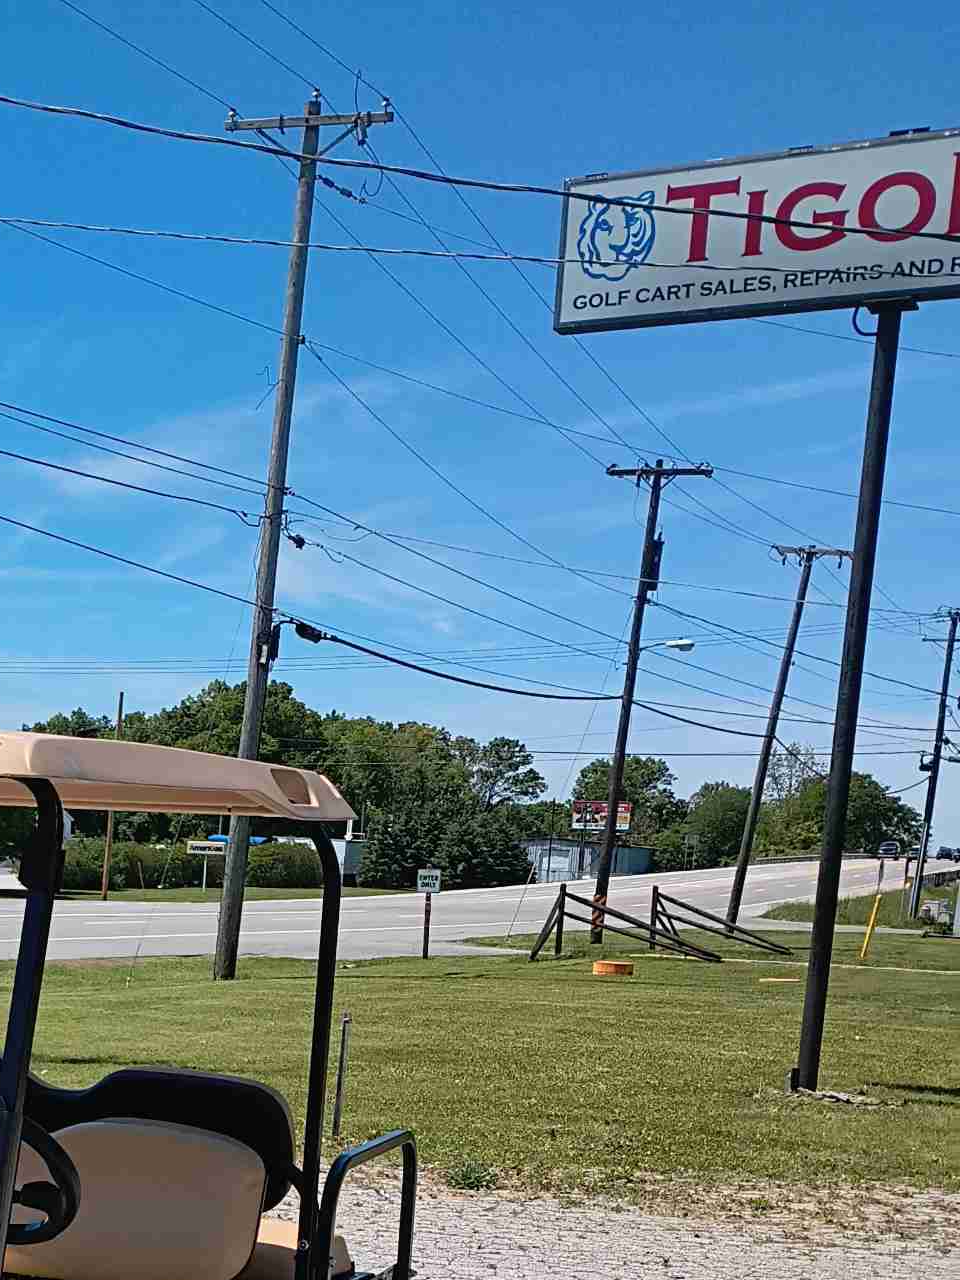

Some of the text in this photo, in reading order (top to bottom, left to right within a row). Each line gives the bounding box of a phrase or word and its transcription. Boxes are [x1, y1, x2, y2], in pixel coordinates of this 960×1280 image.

[665, 150, 960, 263] TIGO
[572, 289, 632, 309] GOLF
[635, 282, 696, 304] CART
[699, 275, 777, 297] SALES,
[783, 264, 884, 289] REPAIRS
[891, 258, 944, 278] AND
